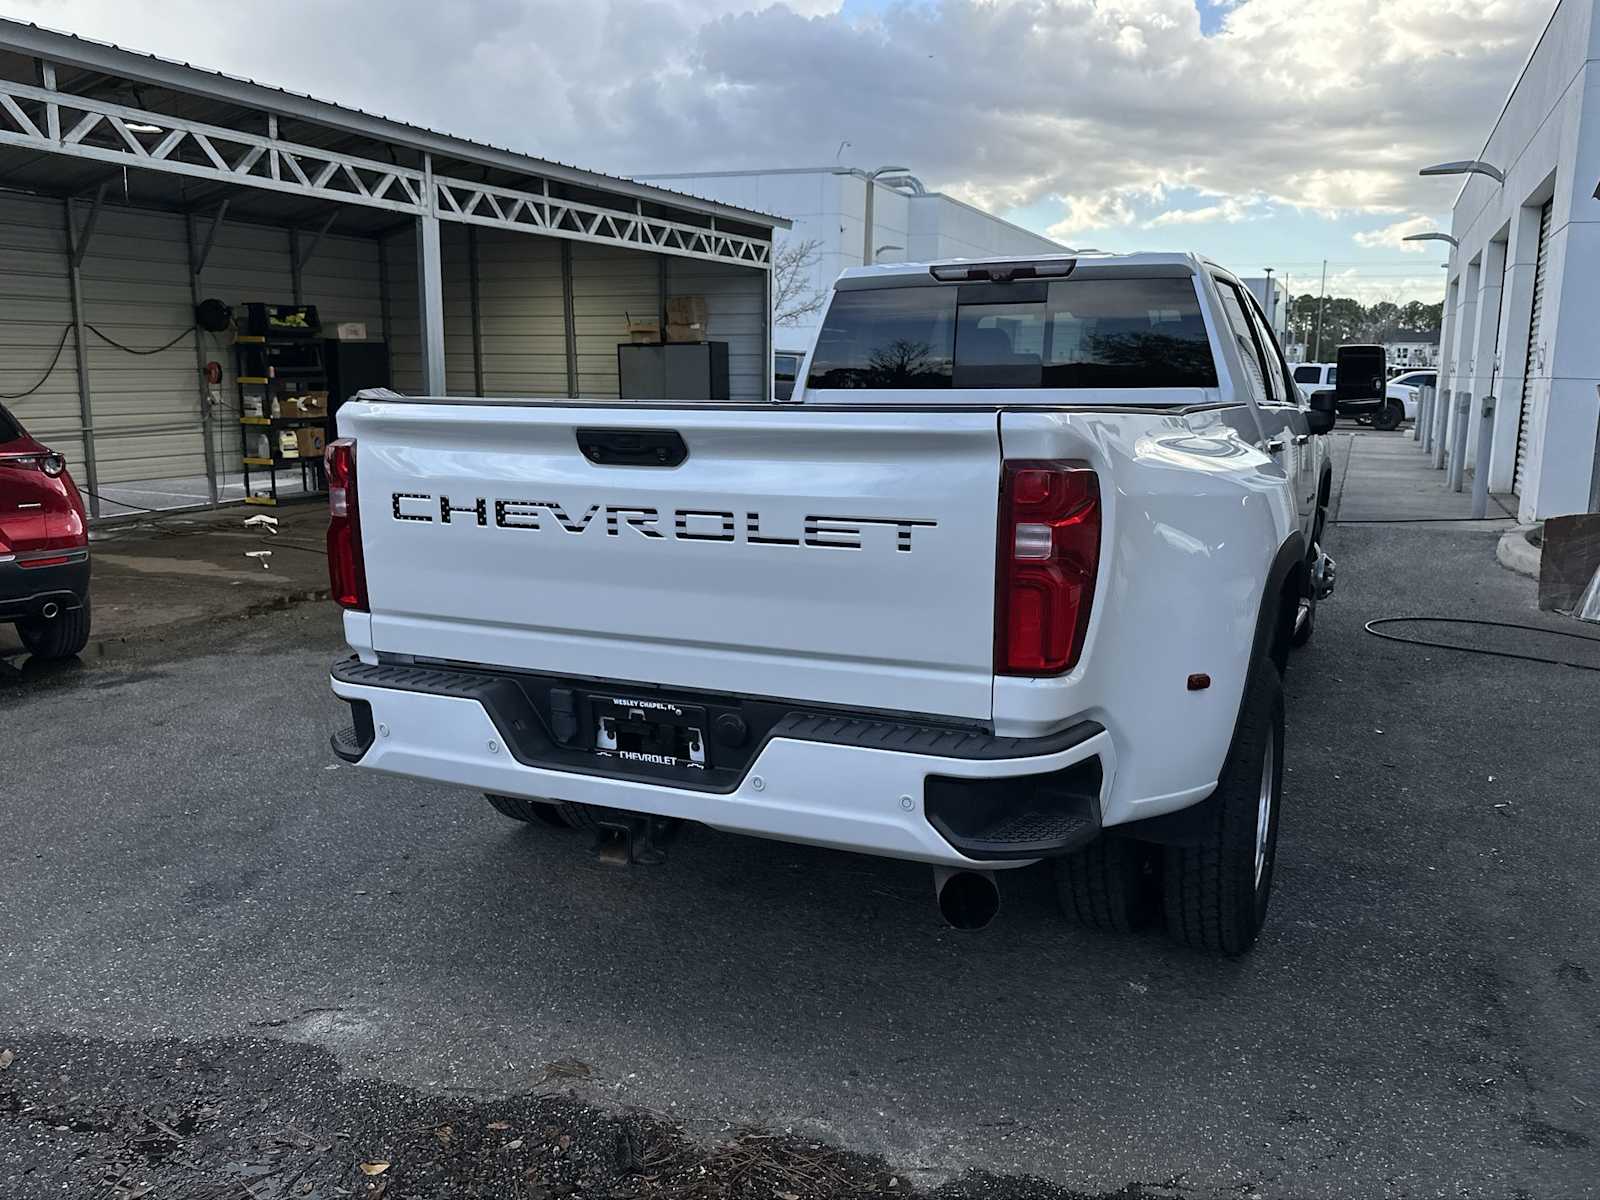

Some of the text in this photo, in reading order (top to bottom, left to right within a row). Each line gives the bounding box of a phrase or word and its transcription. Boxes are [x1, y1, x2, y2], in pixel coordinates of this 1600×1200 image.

[392, 492, 938, 553] CHEVROLET
[612, 698, 639, 707] WESLEY
[620, 751, 677, 766] CHEVROLET
